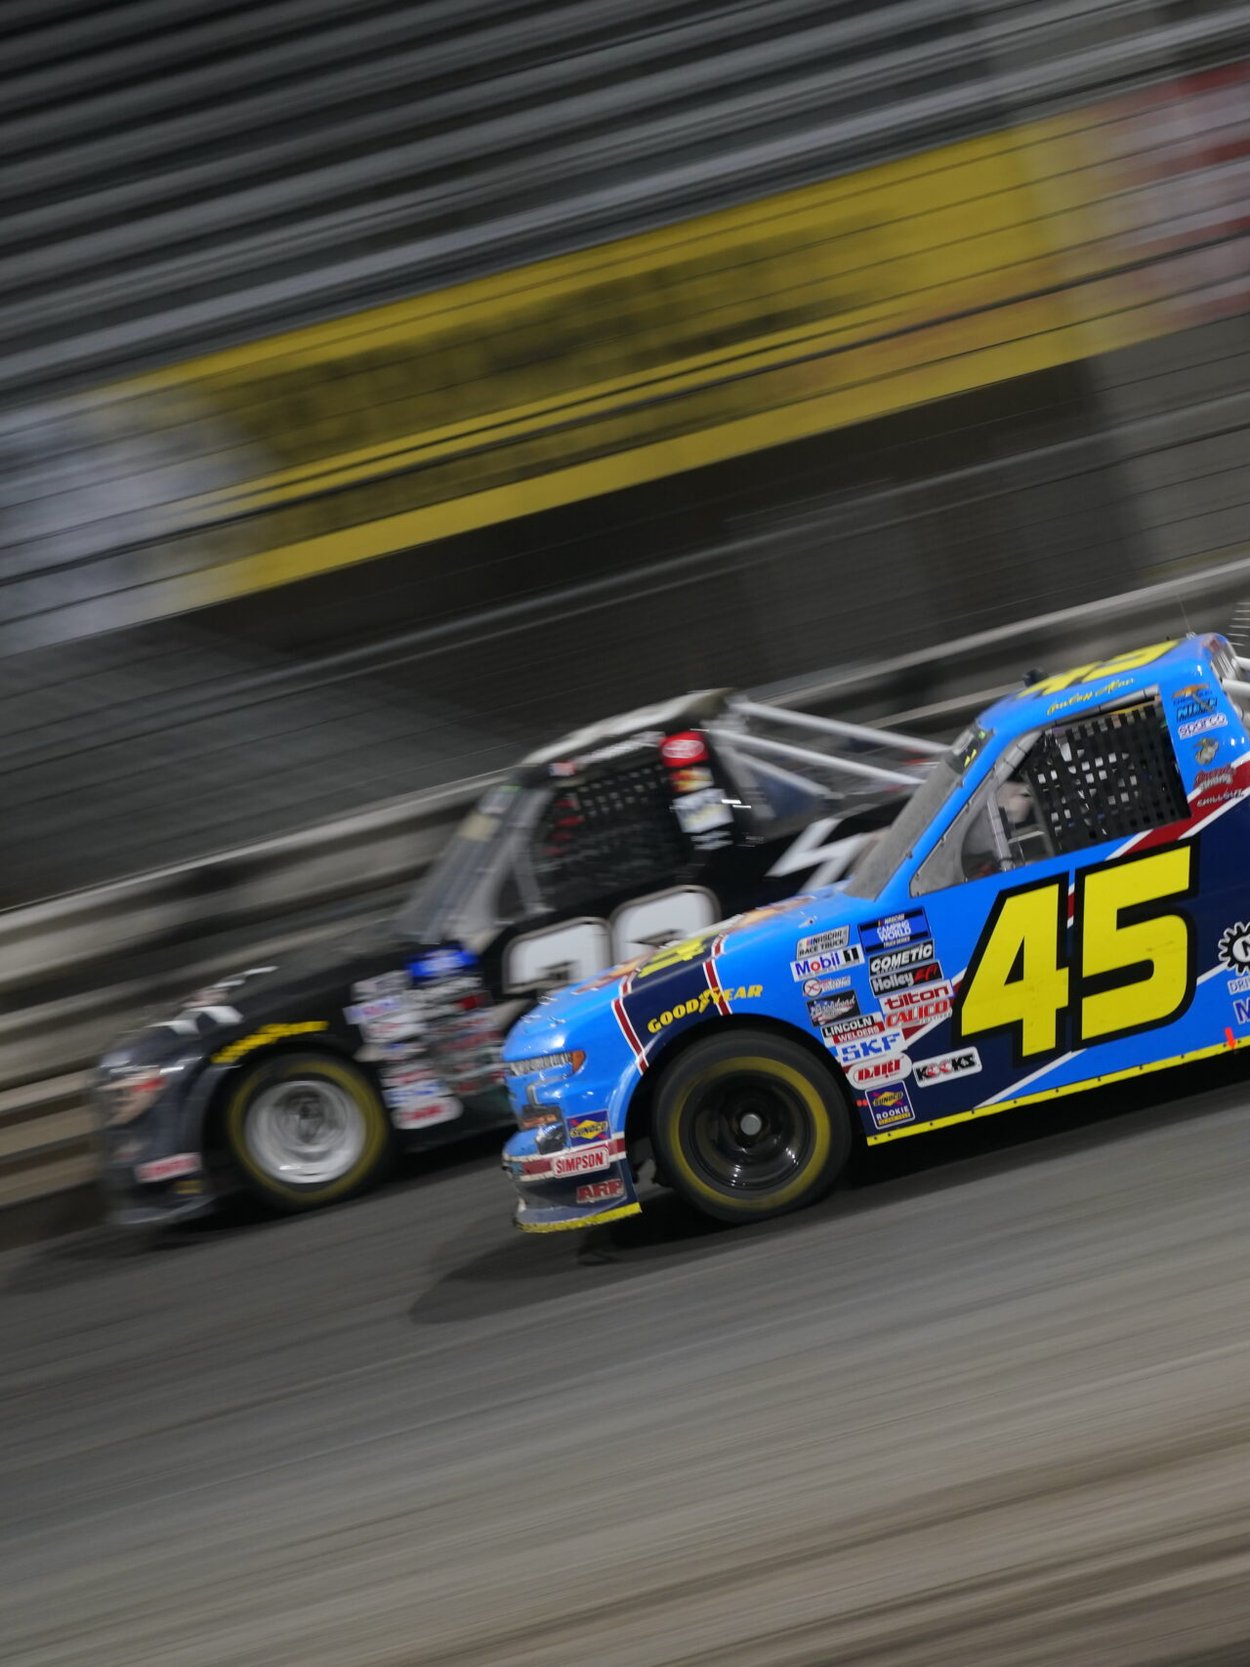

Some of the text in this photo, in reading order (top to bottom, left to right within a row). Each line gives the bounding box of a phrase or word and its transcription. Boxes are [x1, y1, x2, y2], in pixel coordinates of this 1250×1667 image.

[821, 939, 844, 951] TRUCK
[878, 926, 912, 942] WORLD
[870, 943, 933, 973] COMETIC
[961, 845, 1191, 1057] 45
[794, 952, 841, 977] Mobil
[872, 971, 914, 993] Holley
[647, 984, 764, 1034] GOODYEAR
[884, 986, 949, 1010] tilton
[886, 999, 949, 1028] CALICO
[824, 1015, 872, 1037] LINCOLN
[838, 1026, 880, 1043] WELDERS
[841, 1032, 900, 1062] SKF
[914, 1053, 976, 1082] KOOKS
[876, 1106, 910, 1120] ROOKIE
[556, 1152, 604, 1174] SIMPSON
[578, 1180, 623, 1201] ARP
